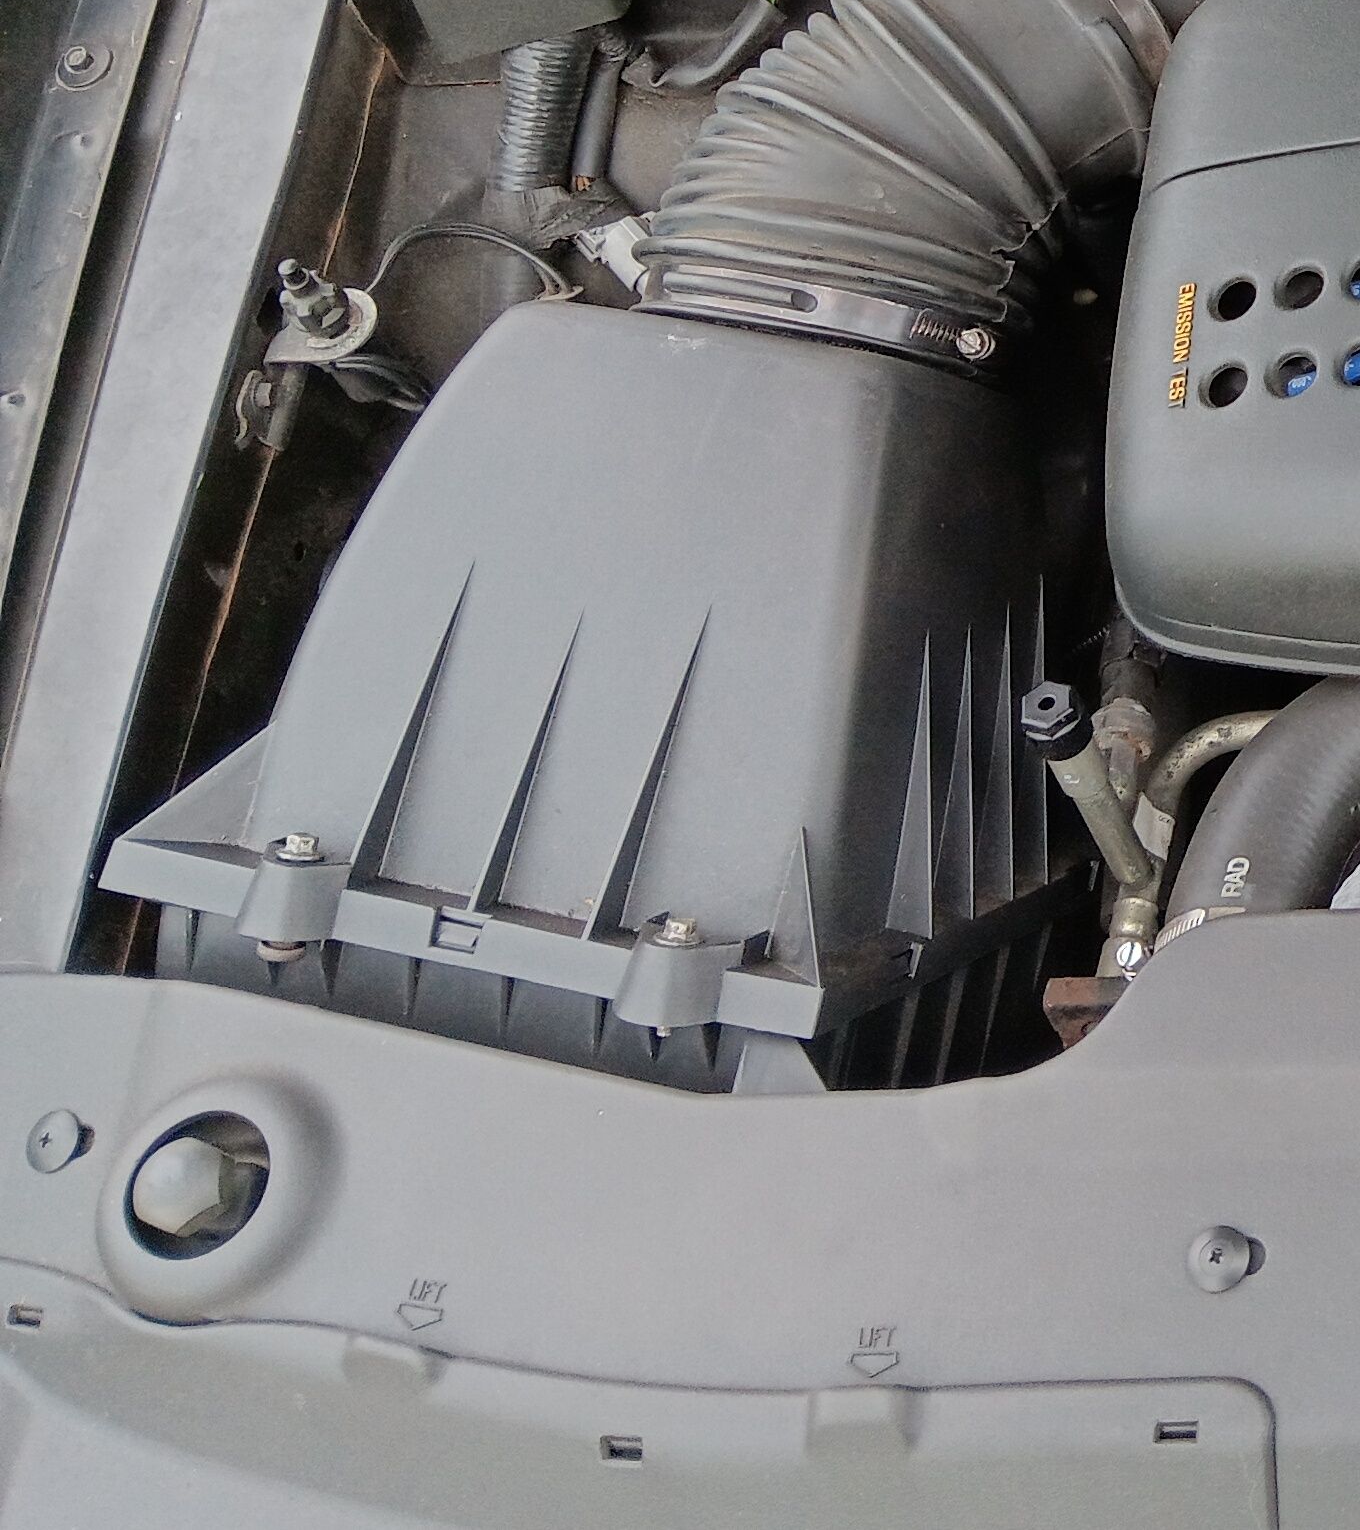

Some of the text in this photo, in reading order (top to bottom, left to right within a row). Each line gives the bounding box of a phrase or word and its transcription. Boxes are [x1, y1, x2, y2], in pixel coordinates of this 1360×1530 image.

[1168, 282, 1197, 408] EMISSION TEST
[1221, 857, 1250, 898] RAD
[858, 1326, 898, 1348] LIFT
